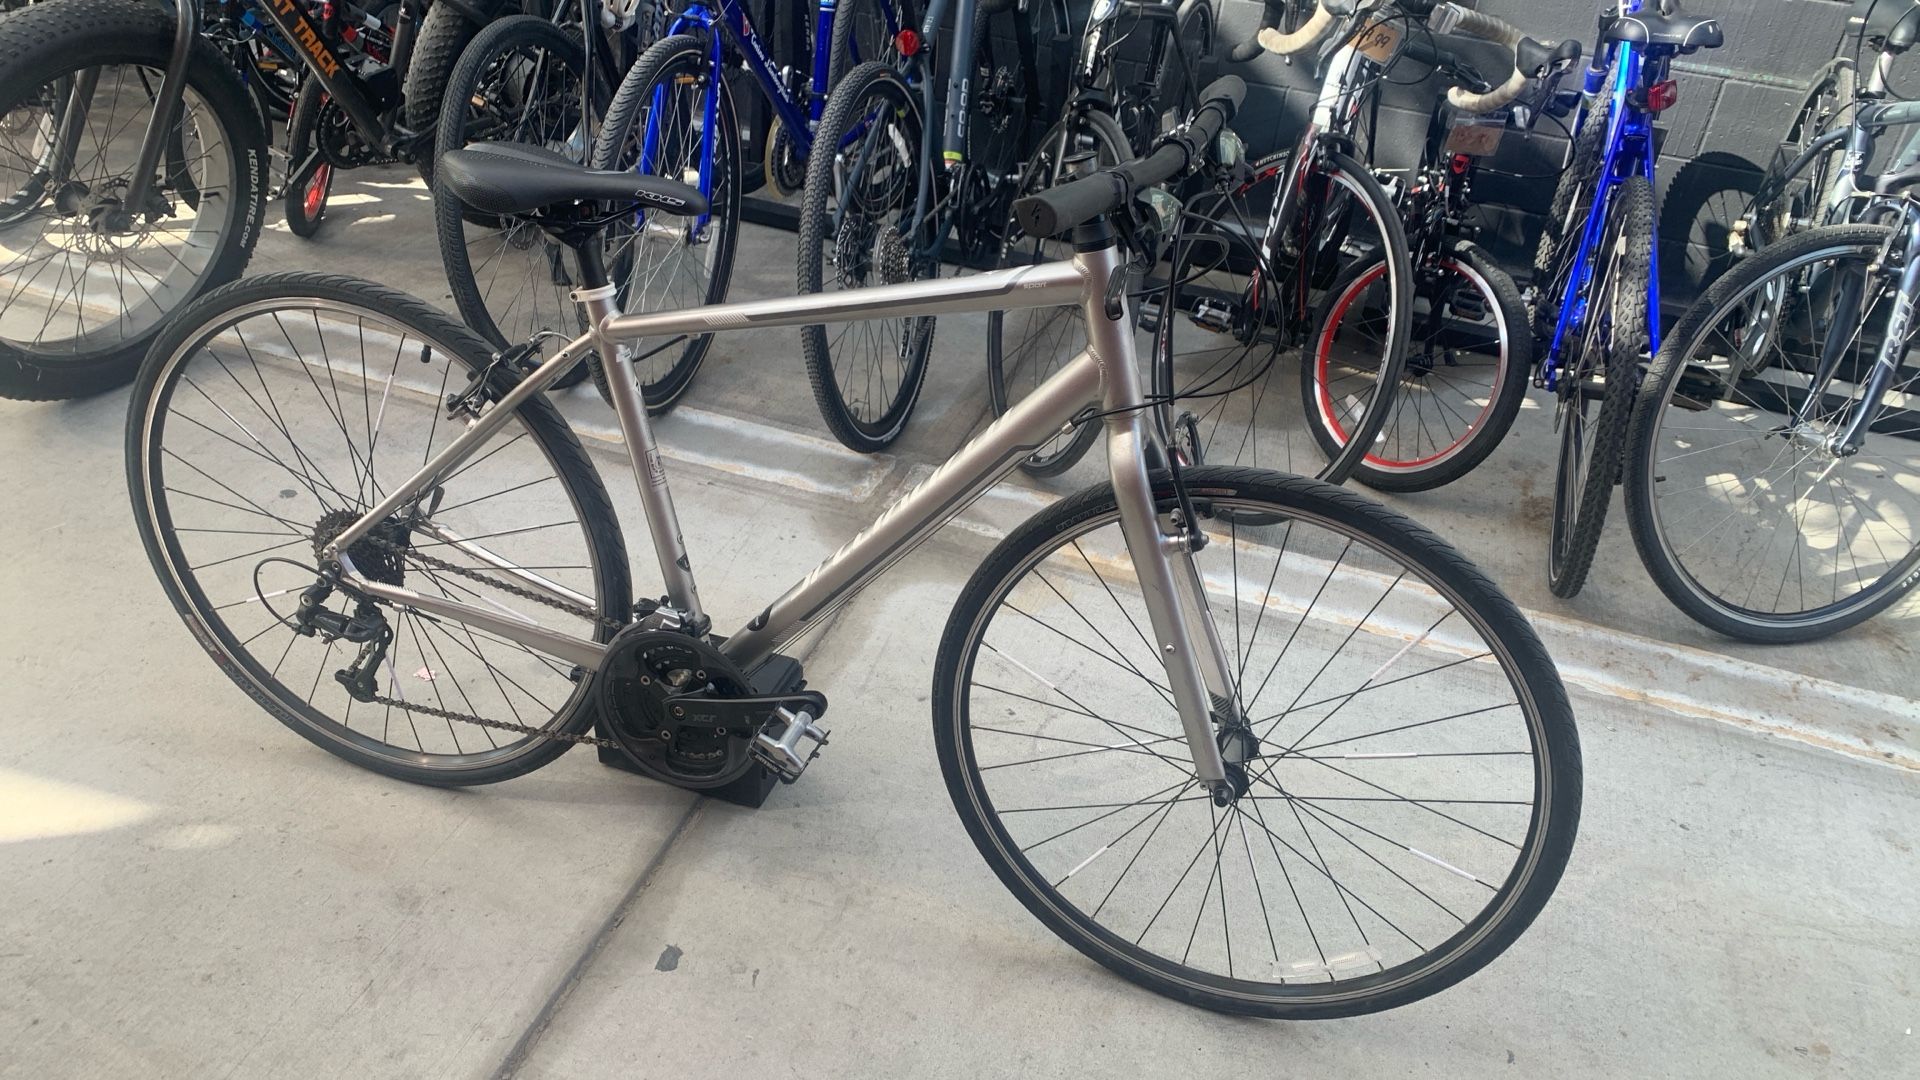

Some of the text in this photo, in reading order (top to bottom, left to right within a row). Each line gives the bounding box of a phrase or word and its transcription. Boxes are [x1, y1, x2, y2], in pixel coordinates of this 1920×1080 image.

[294, 15, 340, 79] TRACK
[240, 148, 259, 249] KENDATIRE.COM
[634, 189, 687, 207] KHS
[1881, 291, 1912, 370] RST
